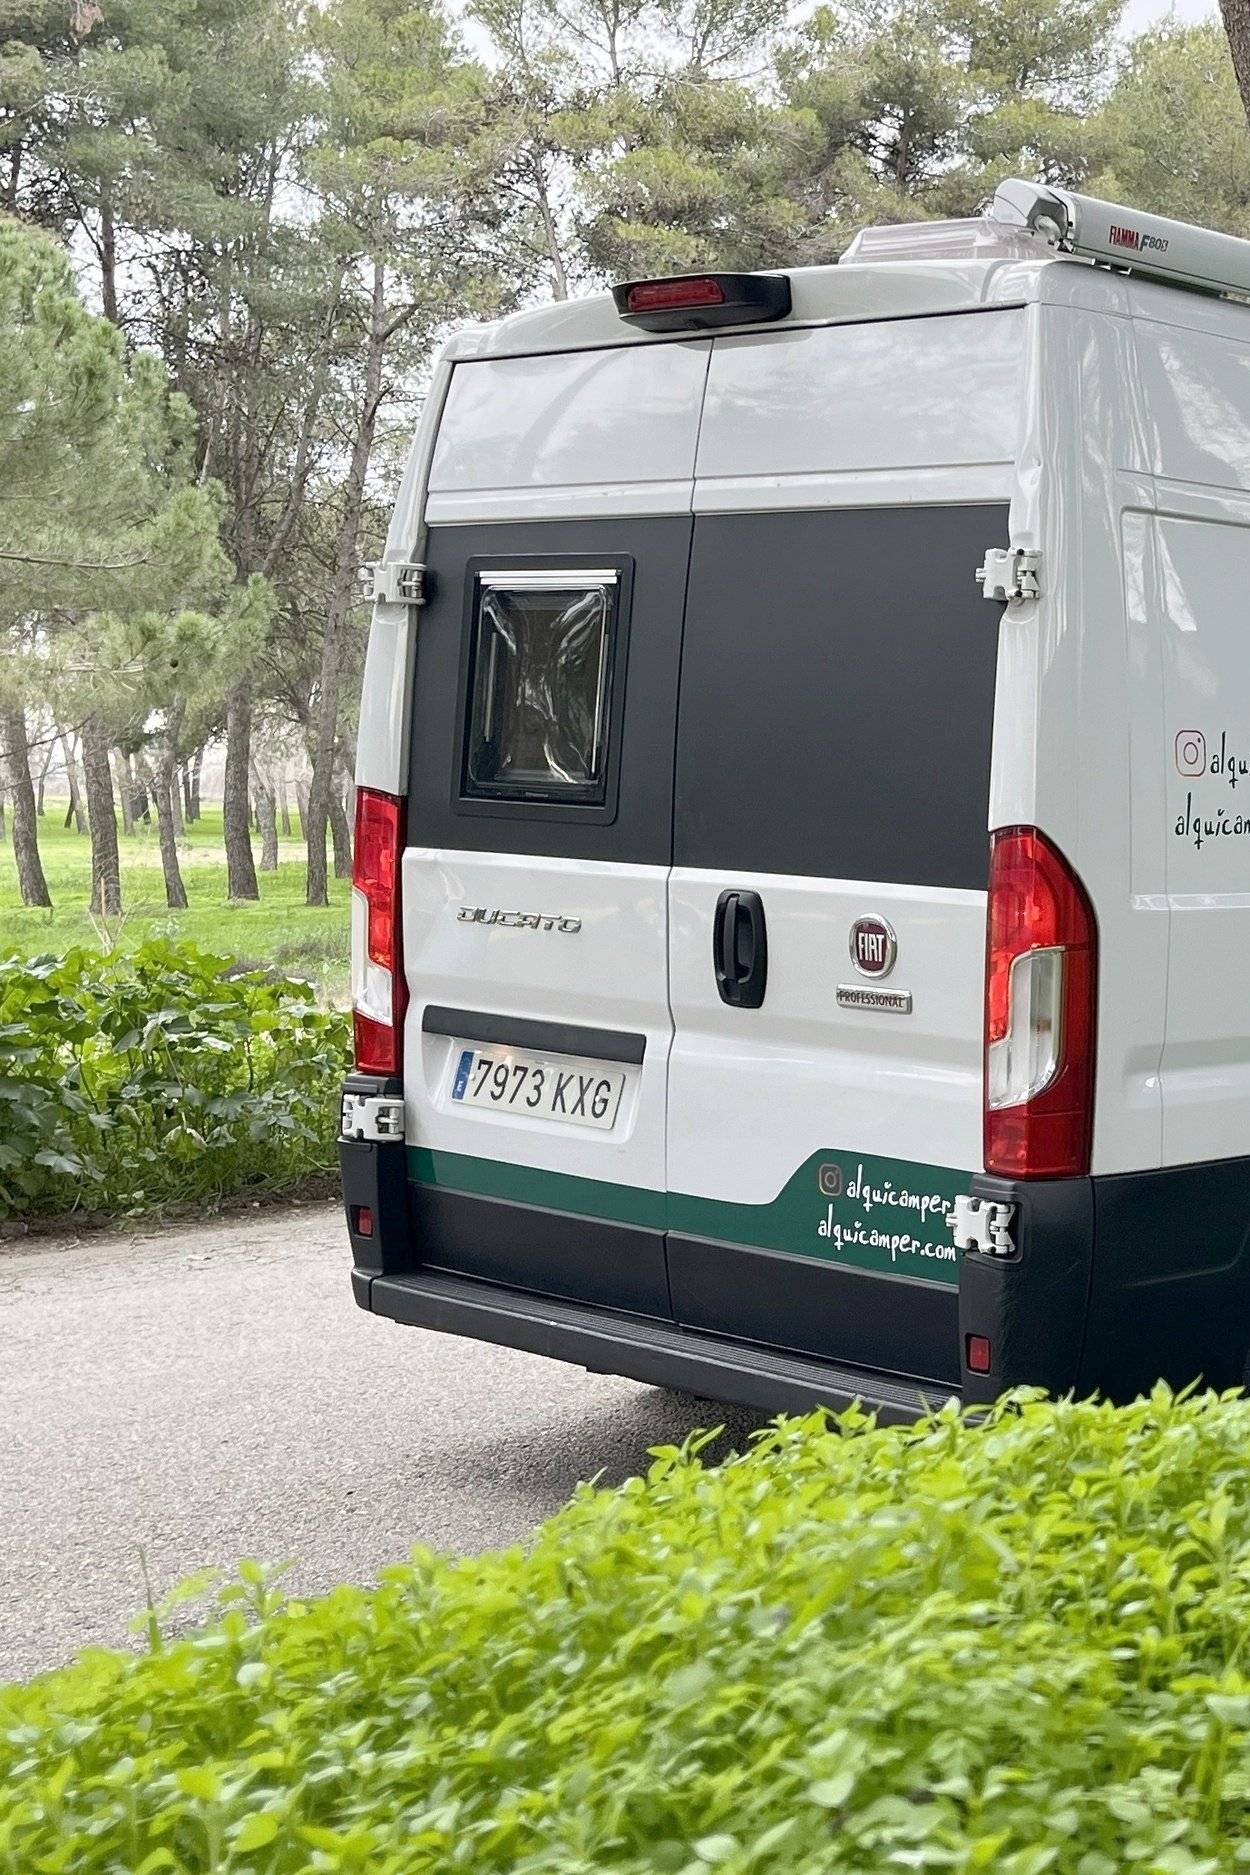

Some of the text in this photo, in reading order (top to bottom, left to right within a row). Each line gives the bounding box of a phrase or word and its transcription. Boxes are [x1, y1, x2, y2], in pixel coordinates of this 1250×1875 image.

[1109, 225, 1139, 251] FIAMMA
[457, 905, 582, 934] DUCATO
[858, 932, 884, 962] FIAT
[838, 990, 904, 1008] PROFESSIONAL
[473, 1058, 611, 1118] 7973 KXG
[846, 1163, 951, 1223] alquicamper
[817, 1203, 956, 1262] alquicamper.com
